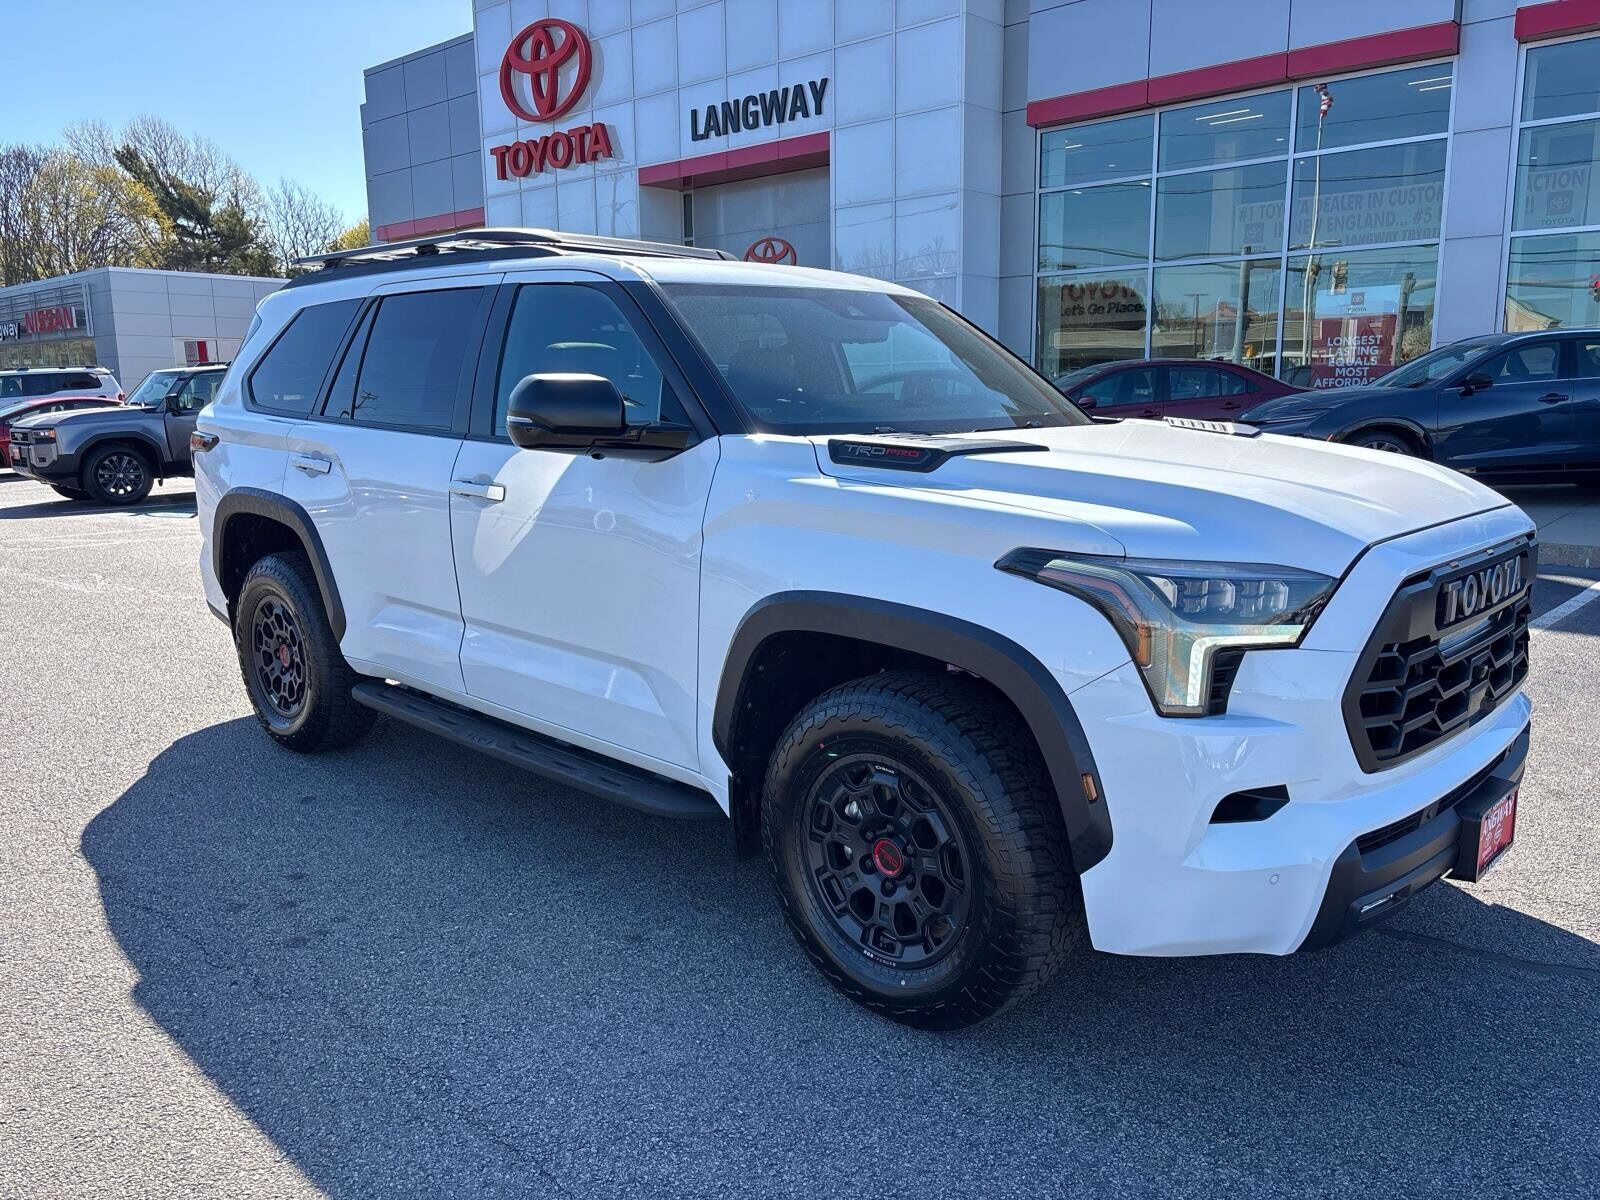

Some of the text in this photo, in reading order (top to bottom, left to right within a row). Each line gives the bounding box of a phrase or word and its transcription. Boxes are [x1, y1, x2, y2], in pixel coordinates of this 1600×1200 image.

[690, 78, 830, 142] LANGWAY
[490, 122, 613, 181] TOYOTA
[1367, 191, 1385, 209] IN
[1087, 303, 1105, 315] Go
[24, 304, 78, 333] NISSAN
[1327, 334, 1383, 347] LONGEST
[1328, 345, 1379, 357] LASTING
[1328, 356, 1378, 367] EQUALS
[1335, 366, 1370, 377] MOST
[844, 443, 886, 457] TRD
[1444, 555, 1521, 623] TOYOTA
